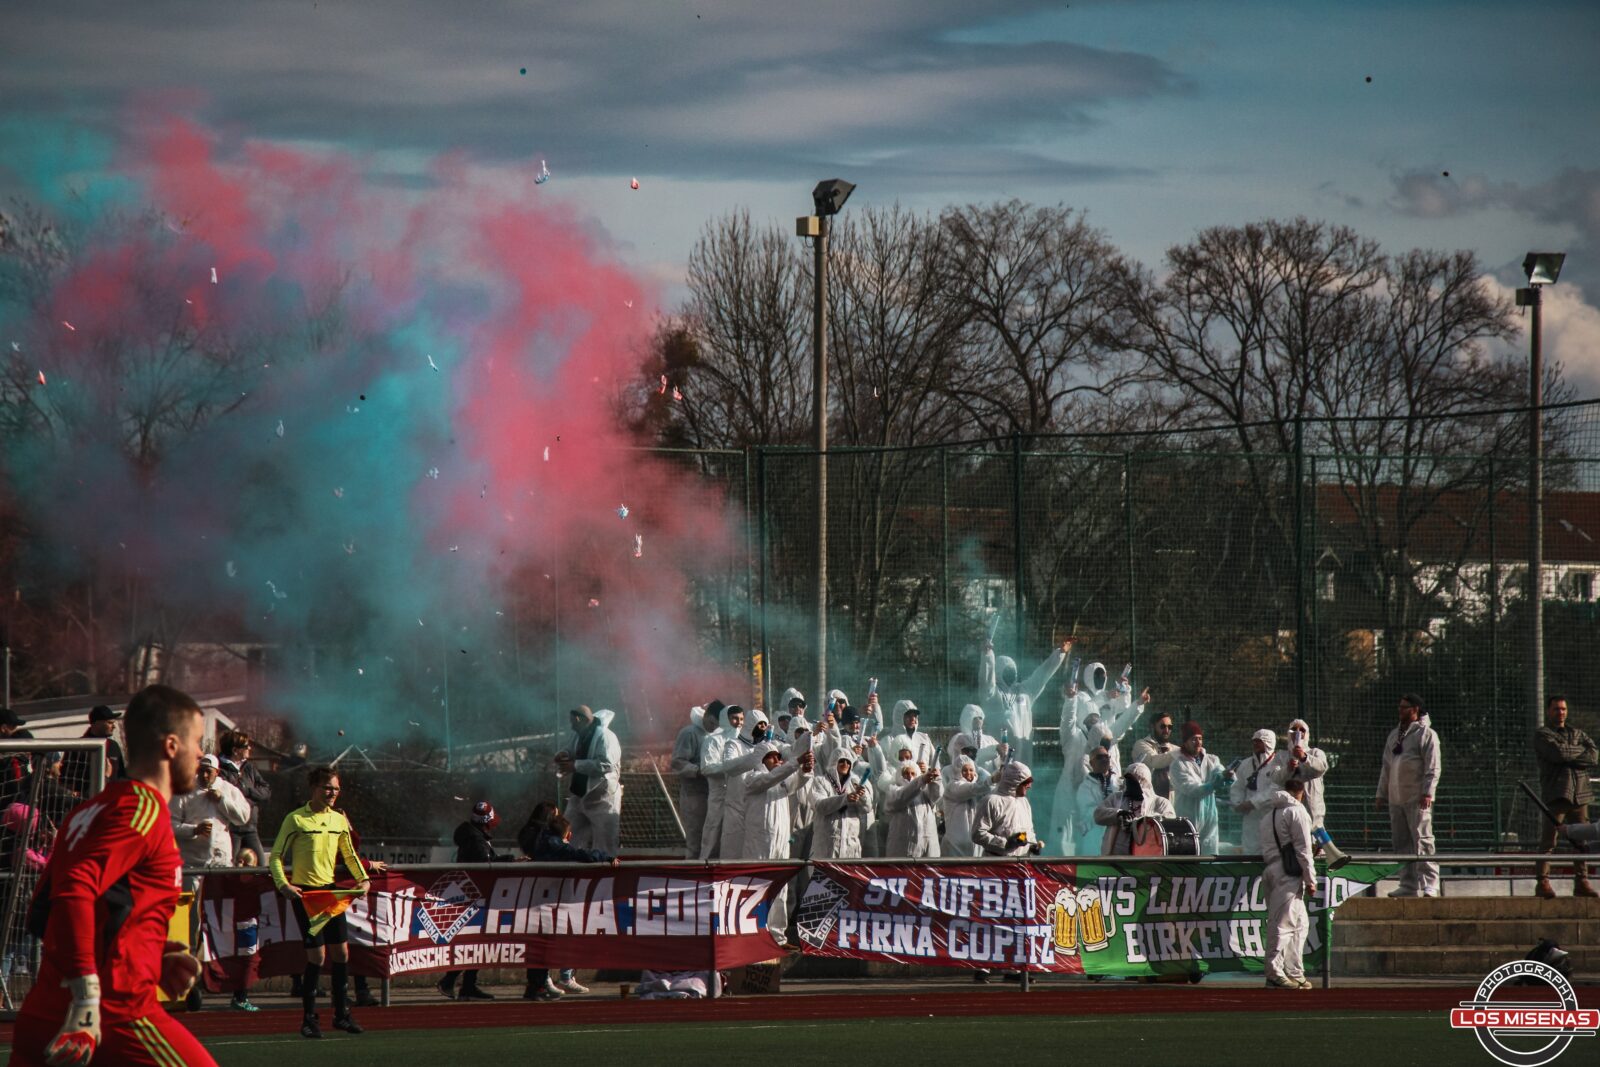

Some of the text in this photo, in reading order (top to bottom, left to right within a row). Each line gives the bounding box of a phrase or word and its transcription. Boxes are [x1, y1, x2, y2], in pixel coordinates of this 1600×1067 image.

[485, 876, 618, 935] PIRNA
[635, 875, 774, 936] COPITZ
[863, 877, 1037, 920] SV AUFBAU
[1098, 875, 1137, 917] VS
[1146, 875, 1268, 915] LIMBAC
[419, 910, 440, 943] PIRNA
[444, 905, 479, 942] COPITZ
[837, 909, 1056, 965] PIRNA COPITZ
[453, 943, 526, 966] SCHWEIZ
